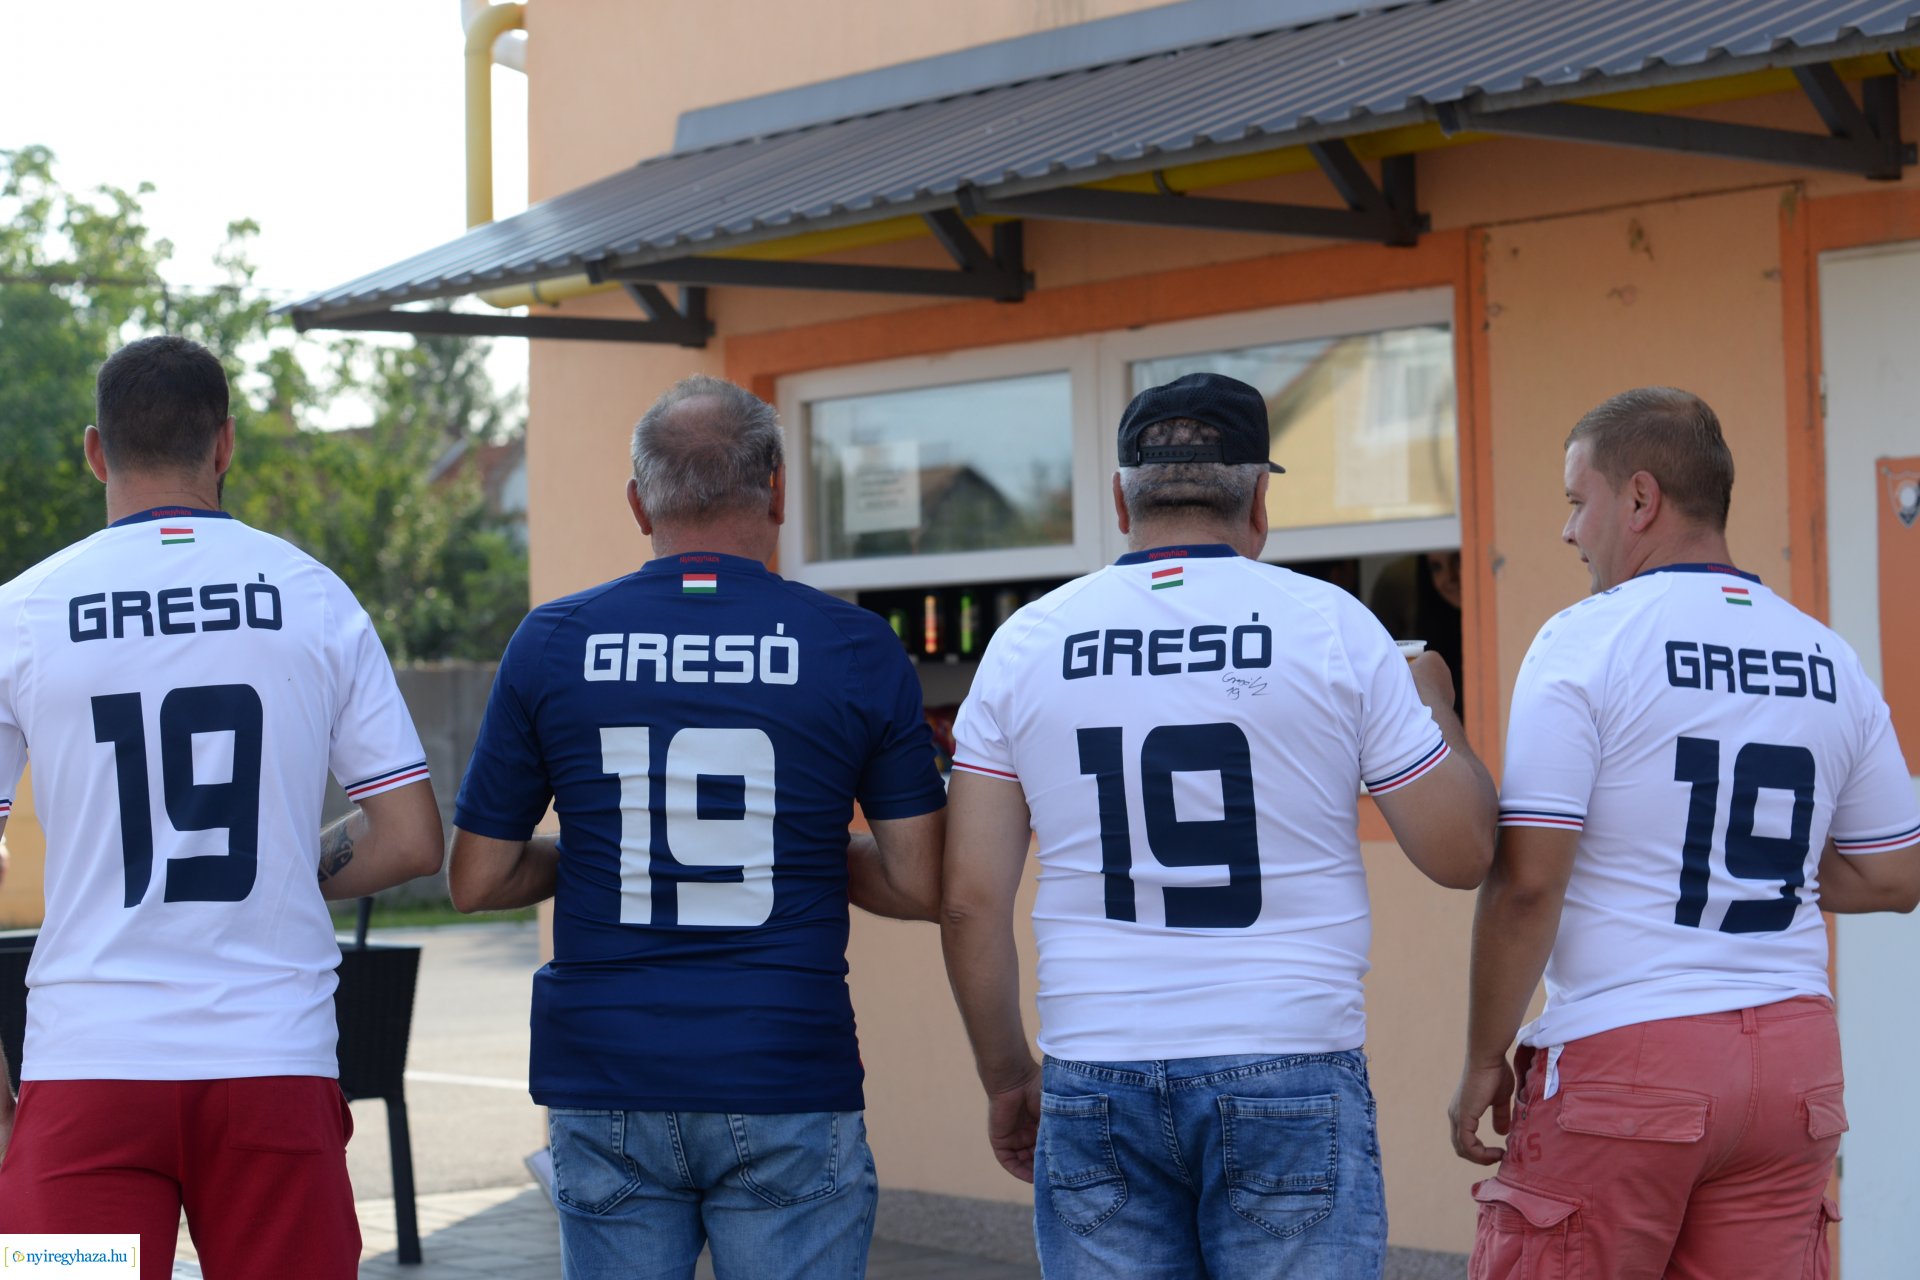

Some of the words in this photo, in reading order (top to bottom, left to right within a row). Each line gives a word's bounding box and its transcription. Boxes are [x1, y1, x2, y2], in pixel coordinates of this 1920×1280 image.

[69, 573, 282, 642] GRESÓ
[584, 623, 798, 685] GRESÓ
[1063, 613, 1272, 680] GRESÓ
[1665, 641, 1836, 704] GRESÓ
[91, 684, 263, 908] 19
[600, 727, 776, 926] 19
[1077, 723, 1262, 928] 19
[1674, 736, 1815, 934] 19
